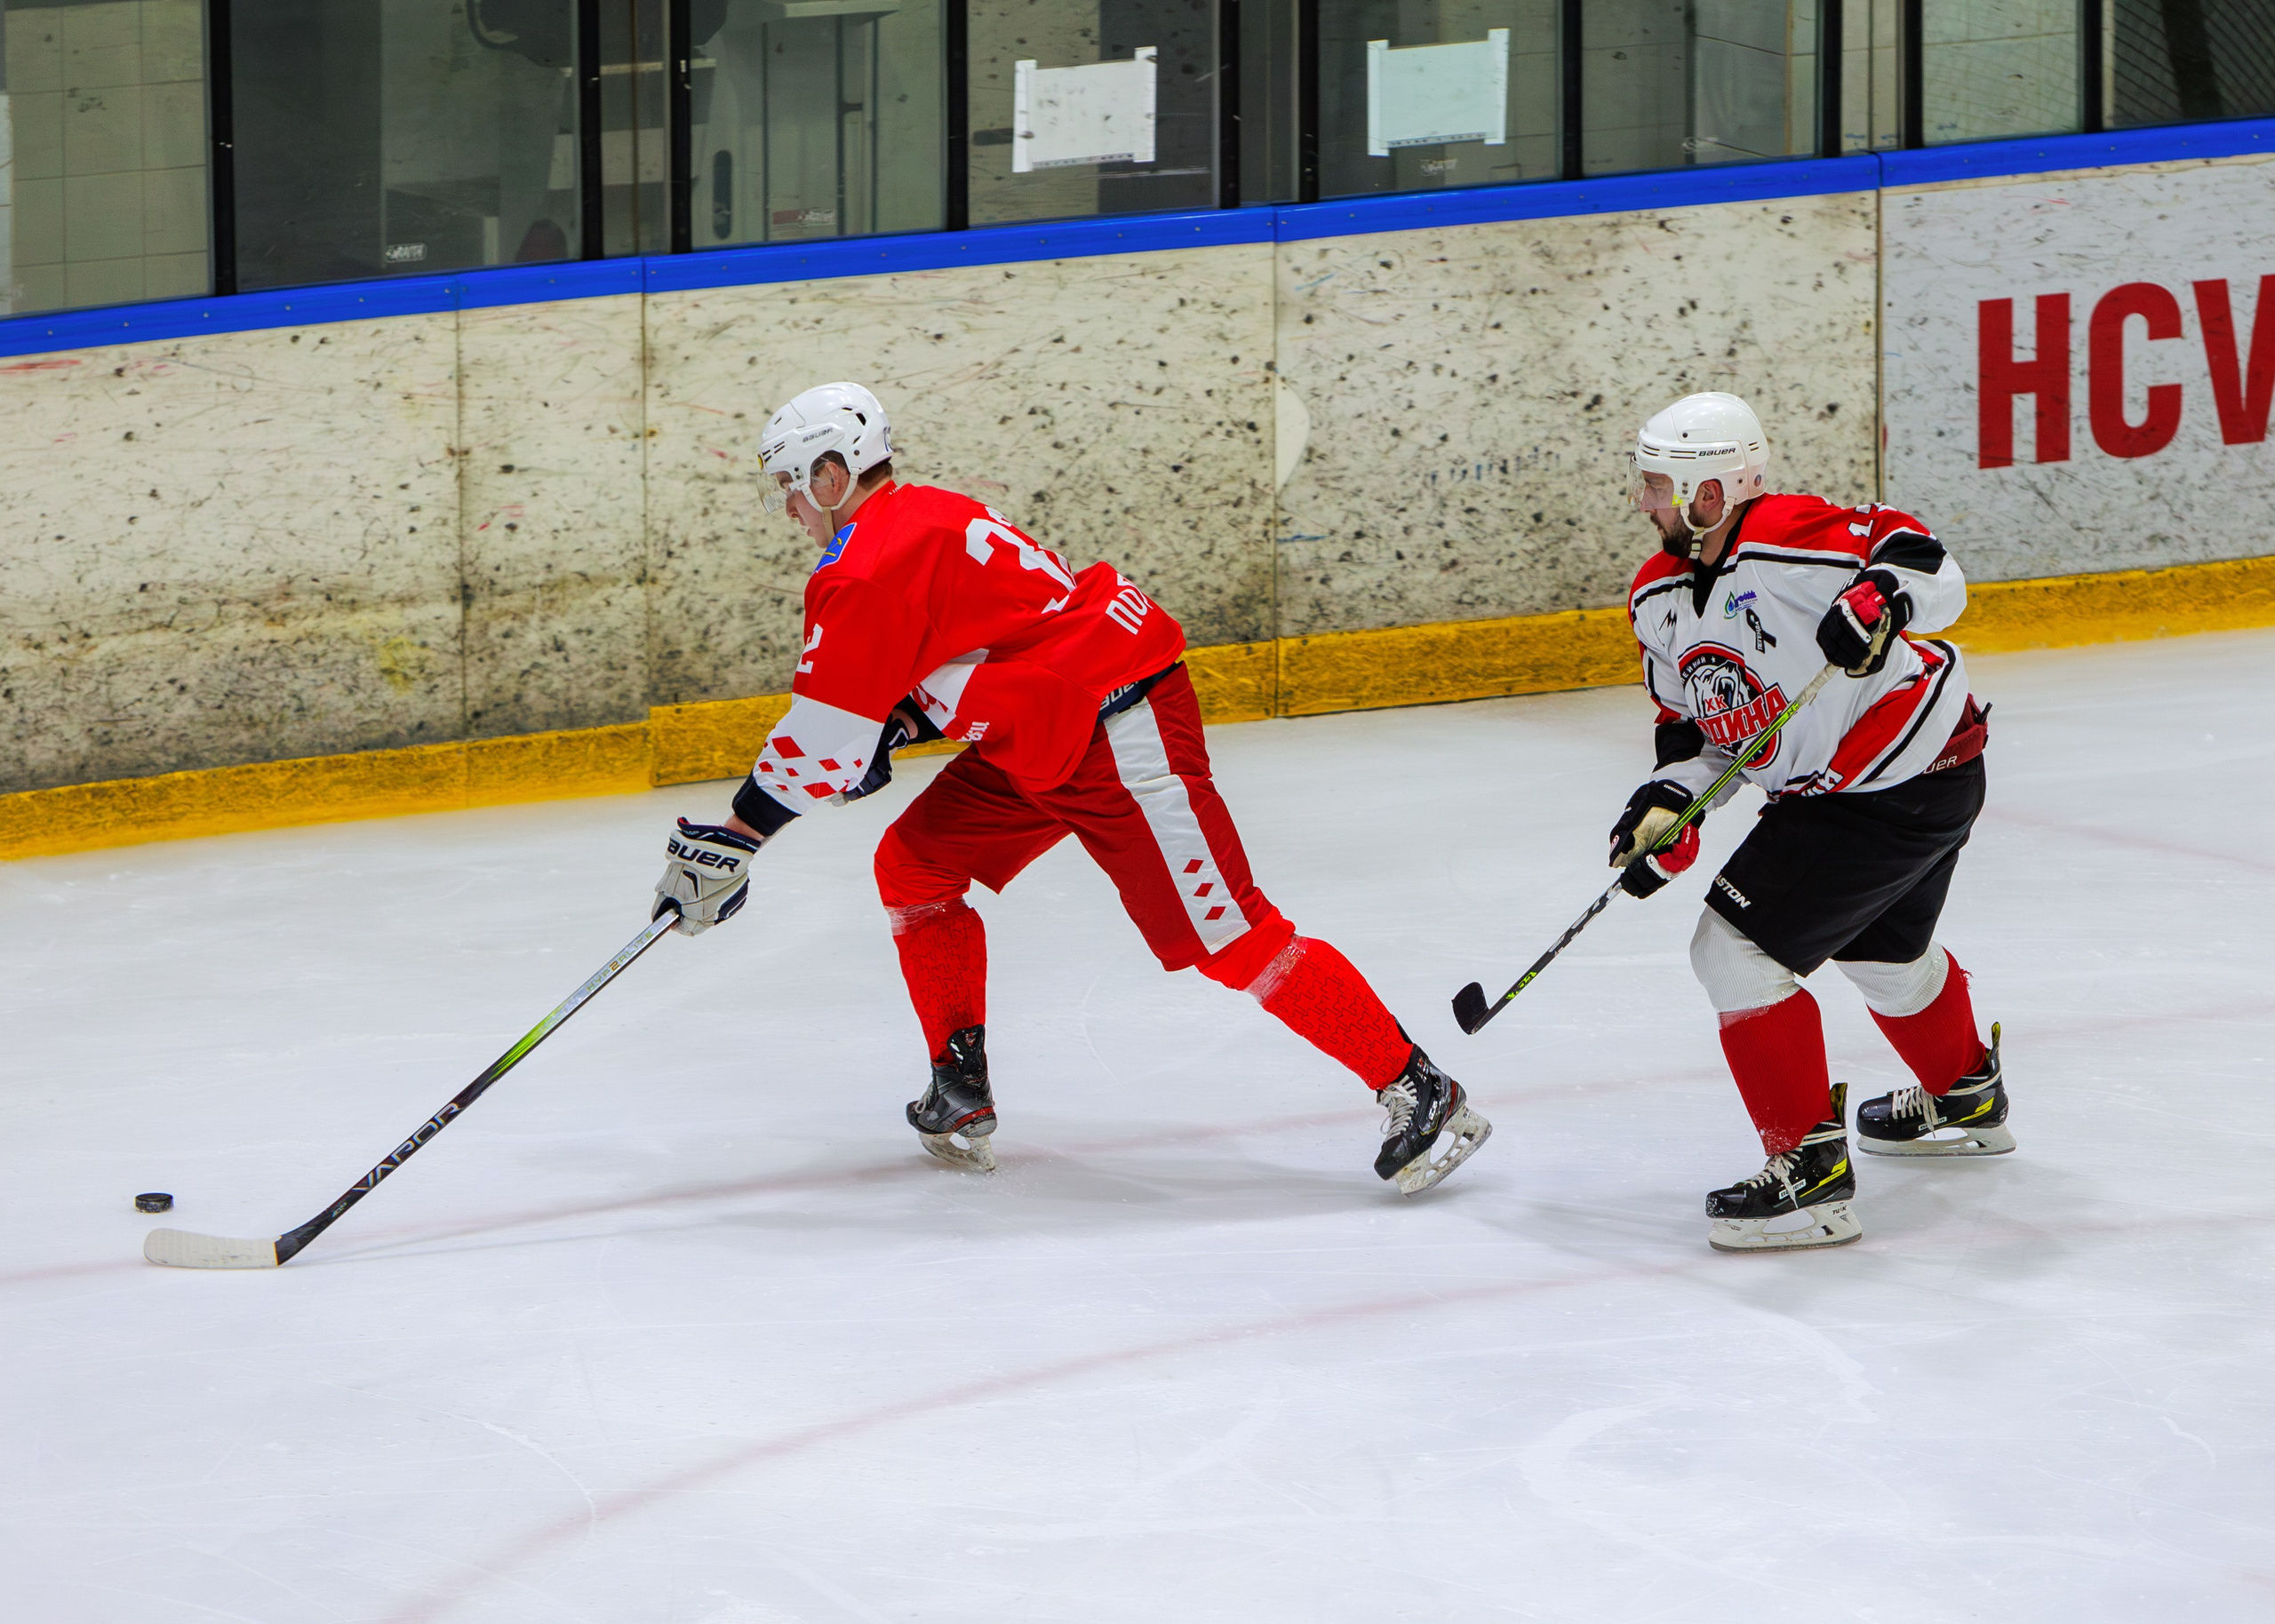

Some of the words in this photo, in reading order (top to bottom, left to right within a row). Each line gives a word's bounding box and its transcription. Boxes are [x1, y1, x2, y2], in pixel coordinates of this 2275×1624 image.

[1698, 447, 1736, 457] BAUER
[1704, 694, 1728, 712] ХК
[667, 837, 740, 872] AUER
[352, 1103, 459, 1190] VAPOR
